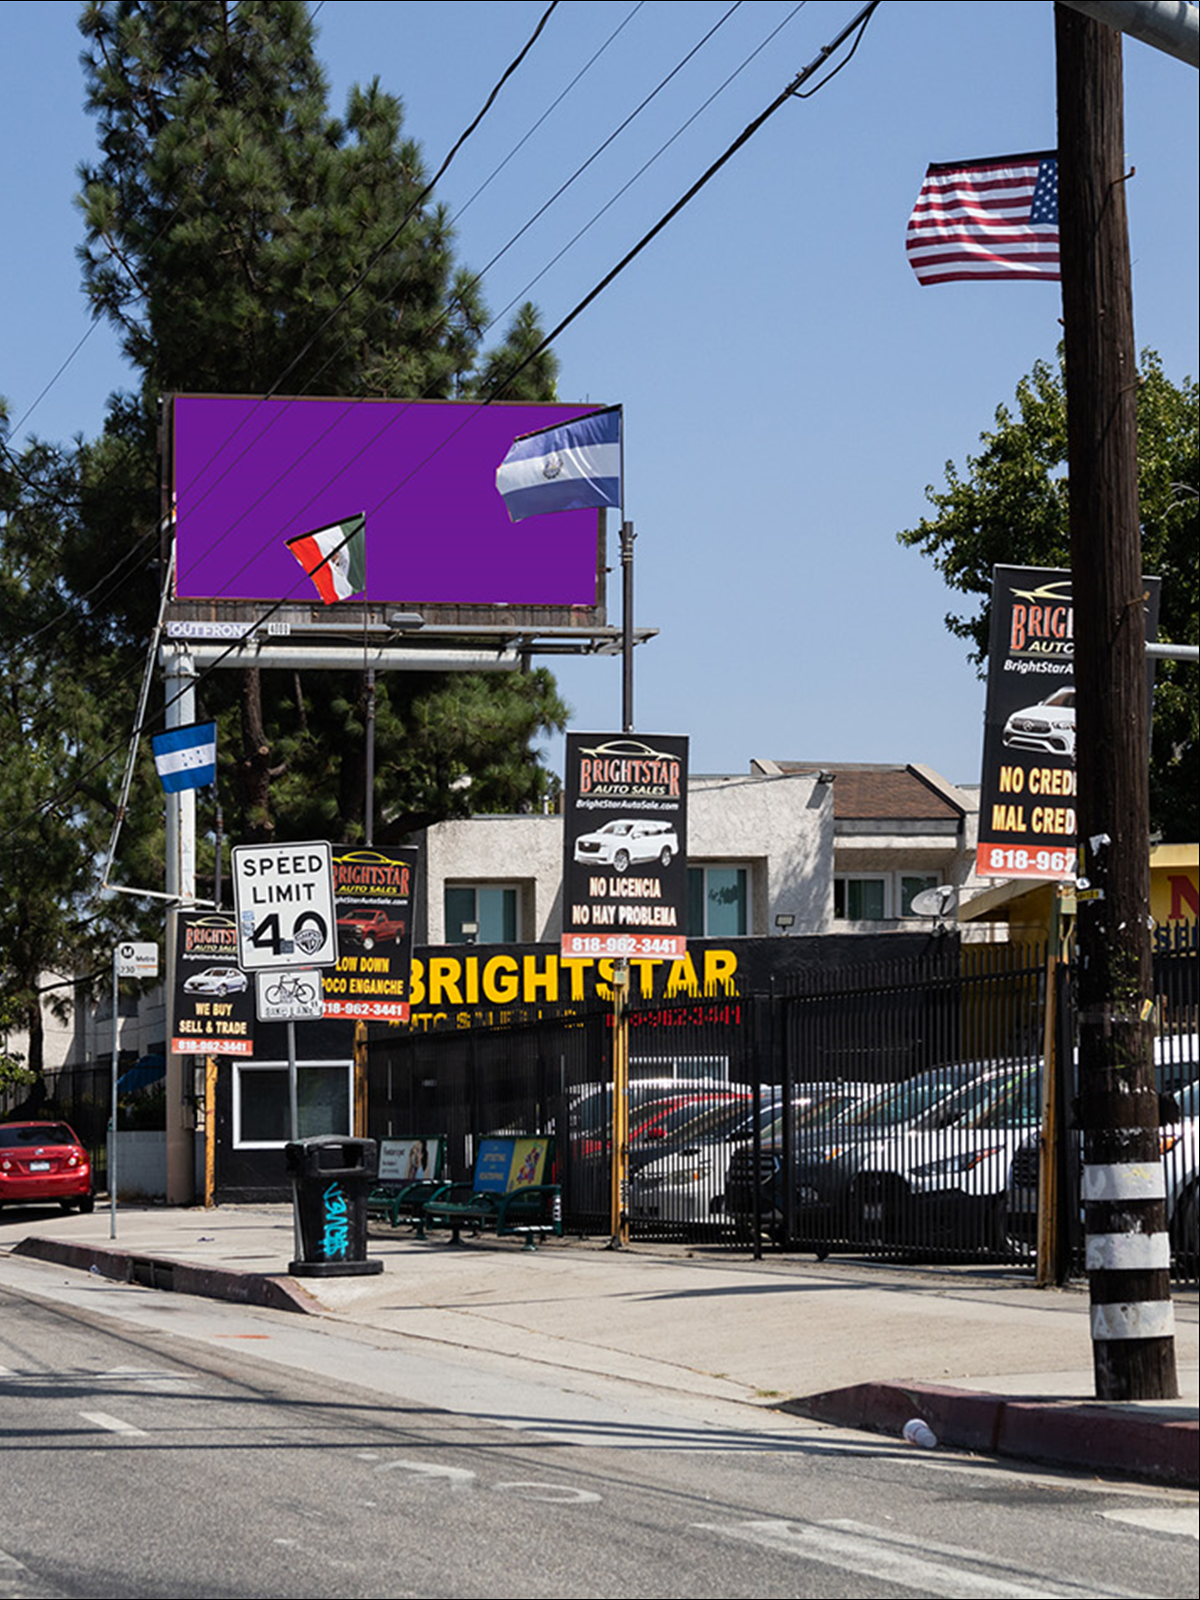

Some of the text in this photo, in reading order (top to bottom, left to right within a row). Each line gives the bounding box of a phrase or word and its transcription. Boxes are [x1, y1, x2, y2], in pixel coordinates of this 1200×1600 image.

[581, 759, 680, 795] BRIGHTSTAR
[999, 766, 1024, 794] NO
[593, 785, 666, 795] AUTO SALES
[992, 805, 1077, 835] MAL CRED
[243, 855, 322, 877] SPEED
[252, 883, 315, 904] LIMIT
[339, 885, 398, 894] AUTO SALES
[589, 877, 662, 898] NO LICENCIA
[572, 905, 677, 927] NO HAY PROBLEMA
[247, 911, 328, 955] 40
[572, 937, 677, 954] 818-962-3441
[336, 956, 390, 973] LOW DOWN
[349, 979, 404, 995] ENGANCHE
[408, 949, 741, 1005] BRIGHTSTAR
[195, 1002, 233, 1016] WE BUY
[179, 1020, 247, 1035] SELL & TRADE
